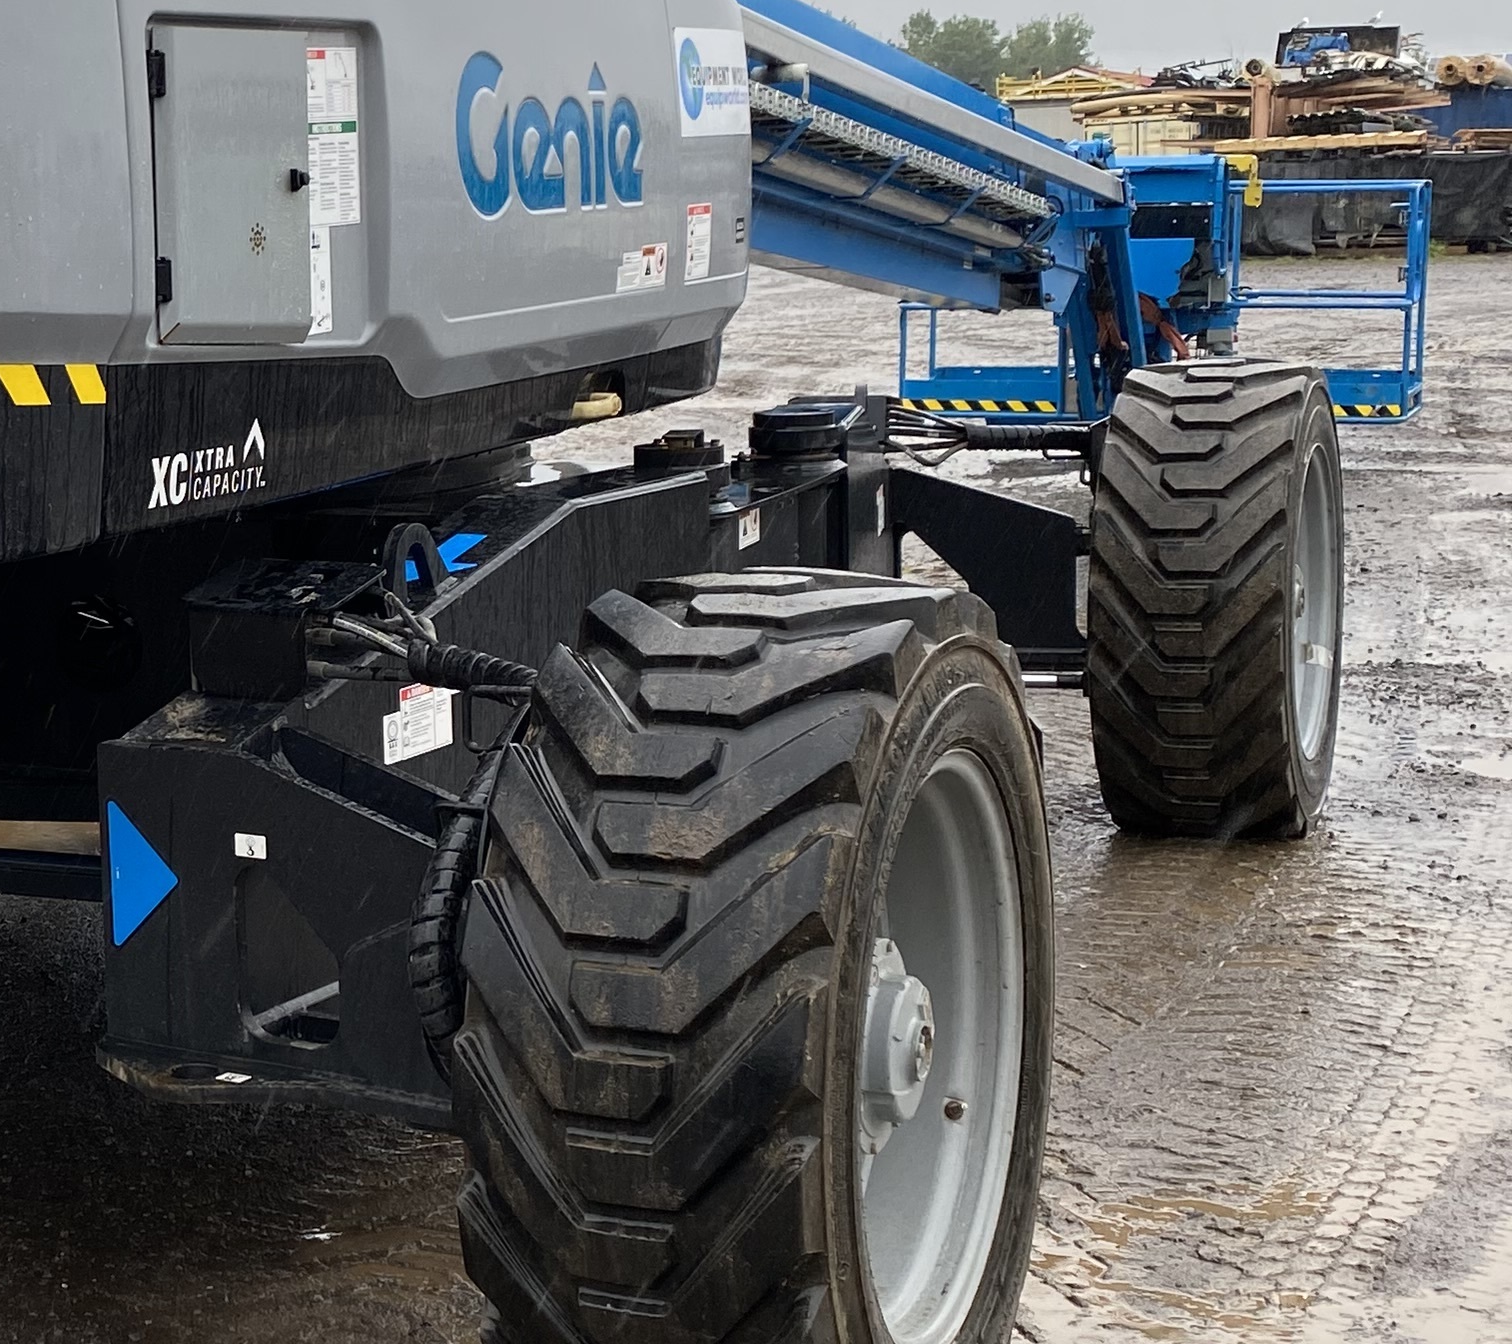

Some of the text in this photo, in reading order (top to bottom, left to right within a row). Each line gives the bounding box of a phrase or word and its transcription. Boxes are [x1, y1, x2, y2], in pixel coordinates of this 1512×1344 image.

[456, 51, 643, 220] Genie
[148, 452, 188, 509] XC
[194, 445, 234, 473] XTRA
[193, 466, 263, 500] CAPACITY
